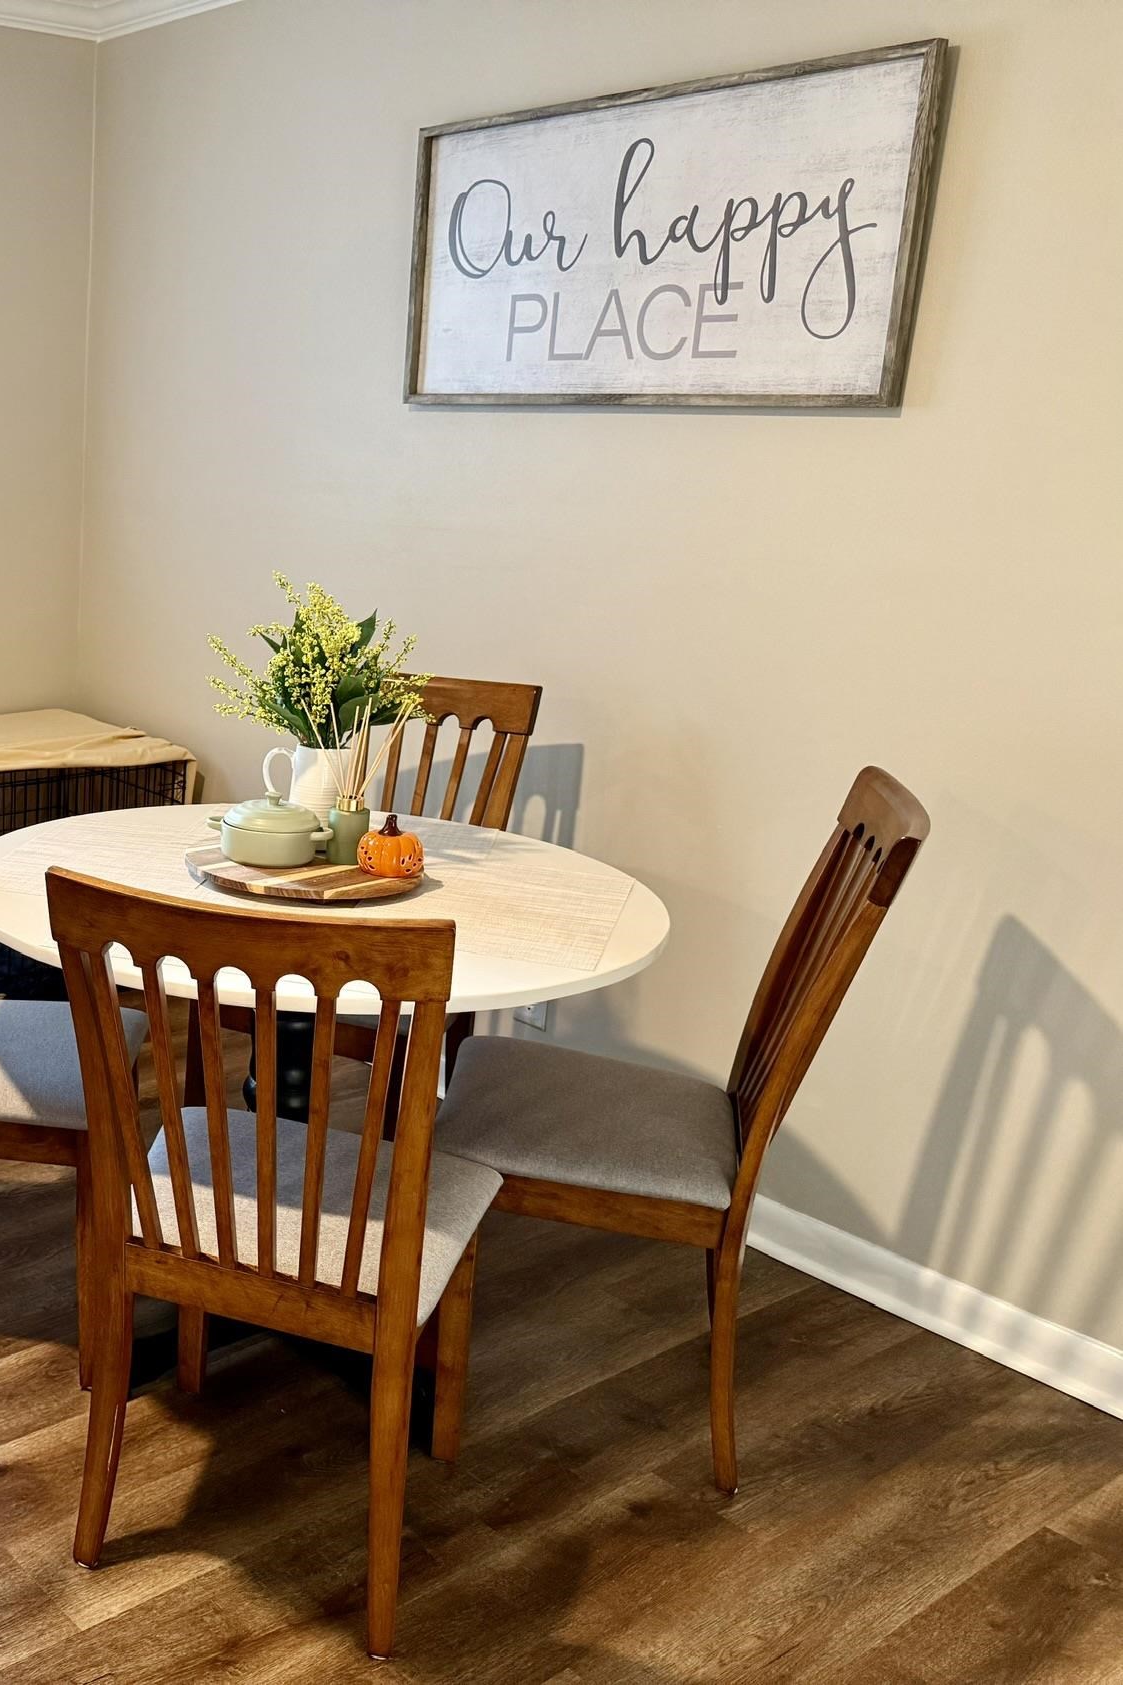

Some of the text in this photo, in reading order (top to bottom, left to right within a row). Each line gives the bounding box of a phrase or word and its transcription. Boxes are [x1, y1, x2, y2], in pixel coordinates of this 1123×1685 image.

[448, 137, 877, 340] Our happy
[505, 281, 744, 362] PLACE
